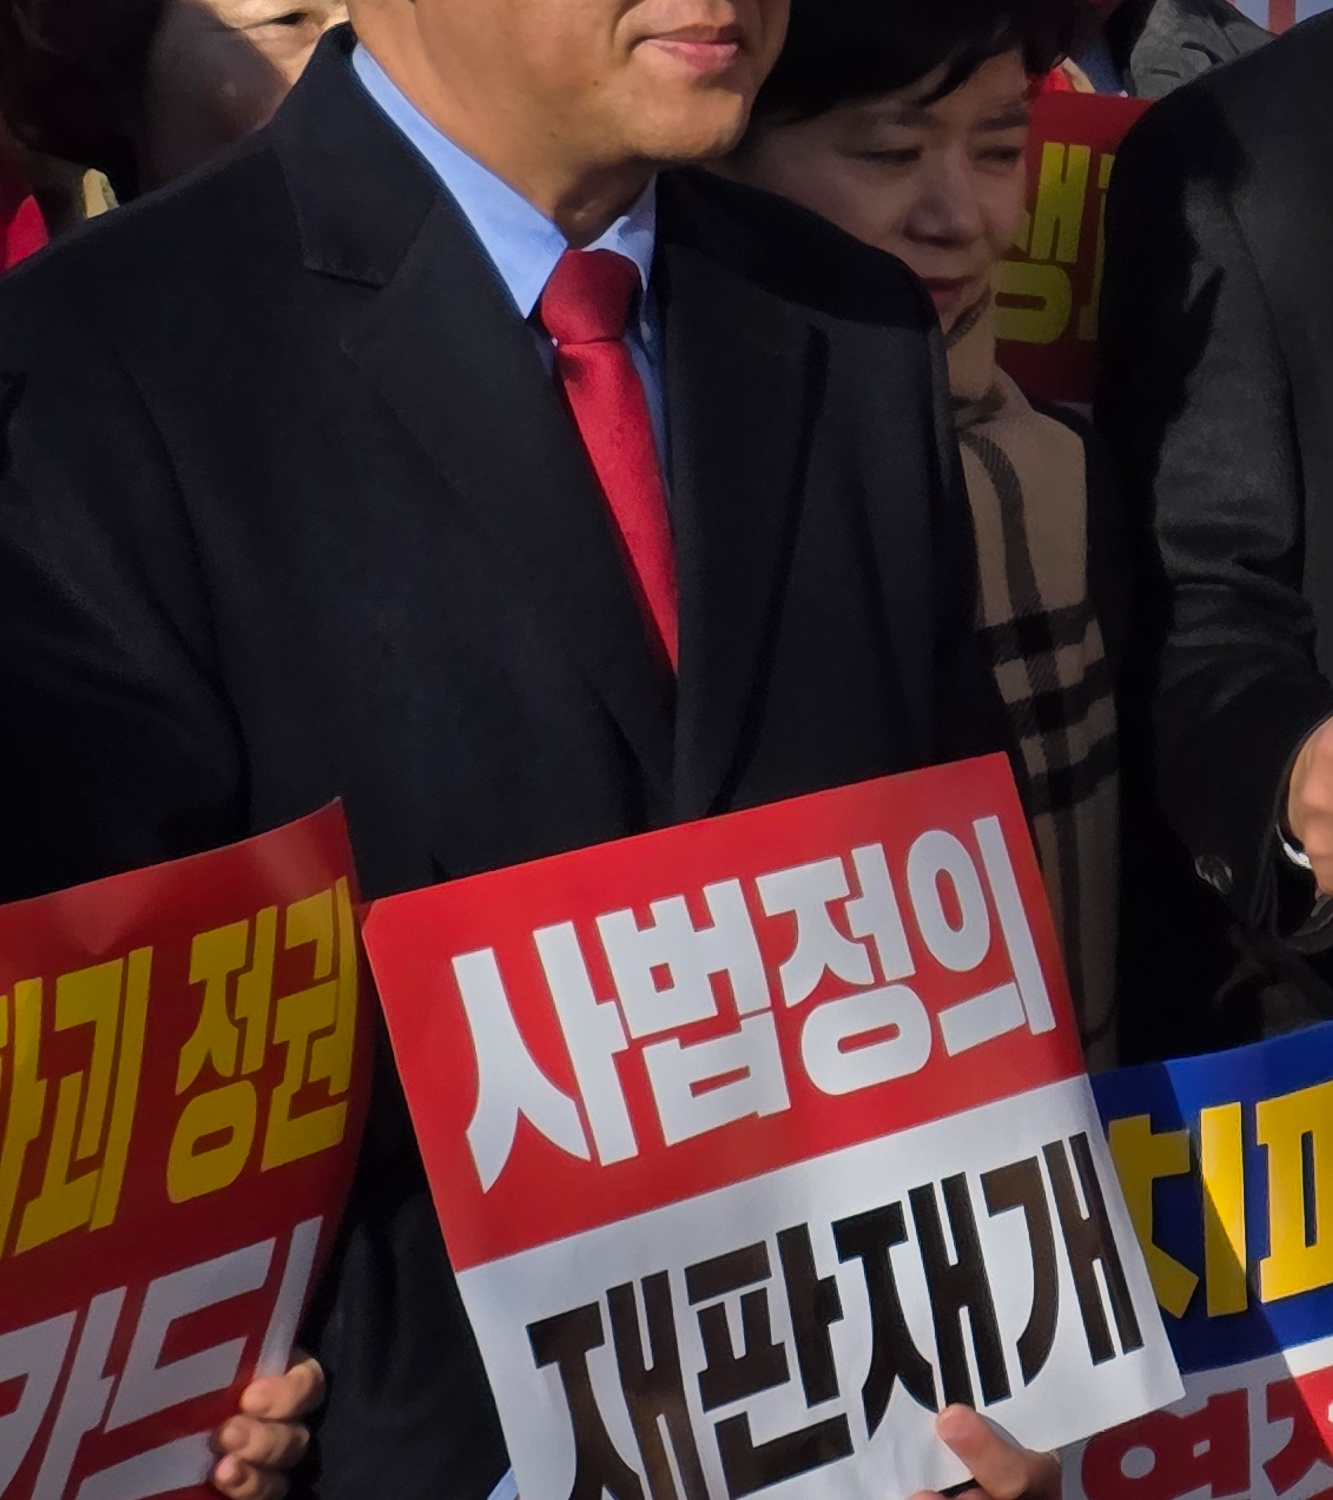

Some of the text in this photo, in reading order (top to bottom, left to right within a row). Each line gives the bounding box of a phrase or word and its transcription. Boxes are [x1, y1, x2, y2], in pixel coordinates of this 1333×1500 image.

[167, 875, 358, 1204] 정권
[451, 815, 1057, 1196] 사법정의
[525, 1131, 1145, 1500] 재판재개
